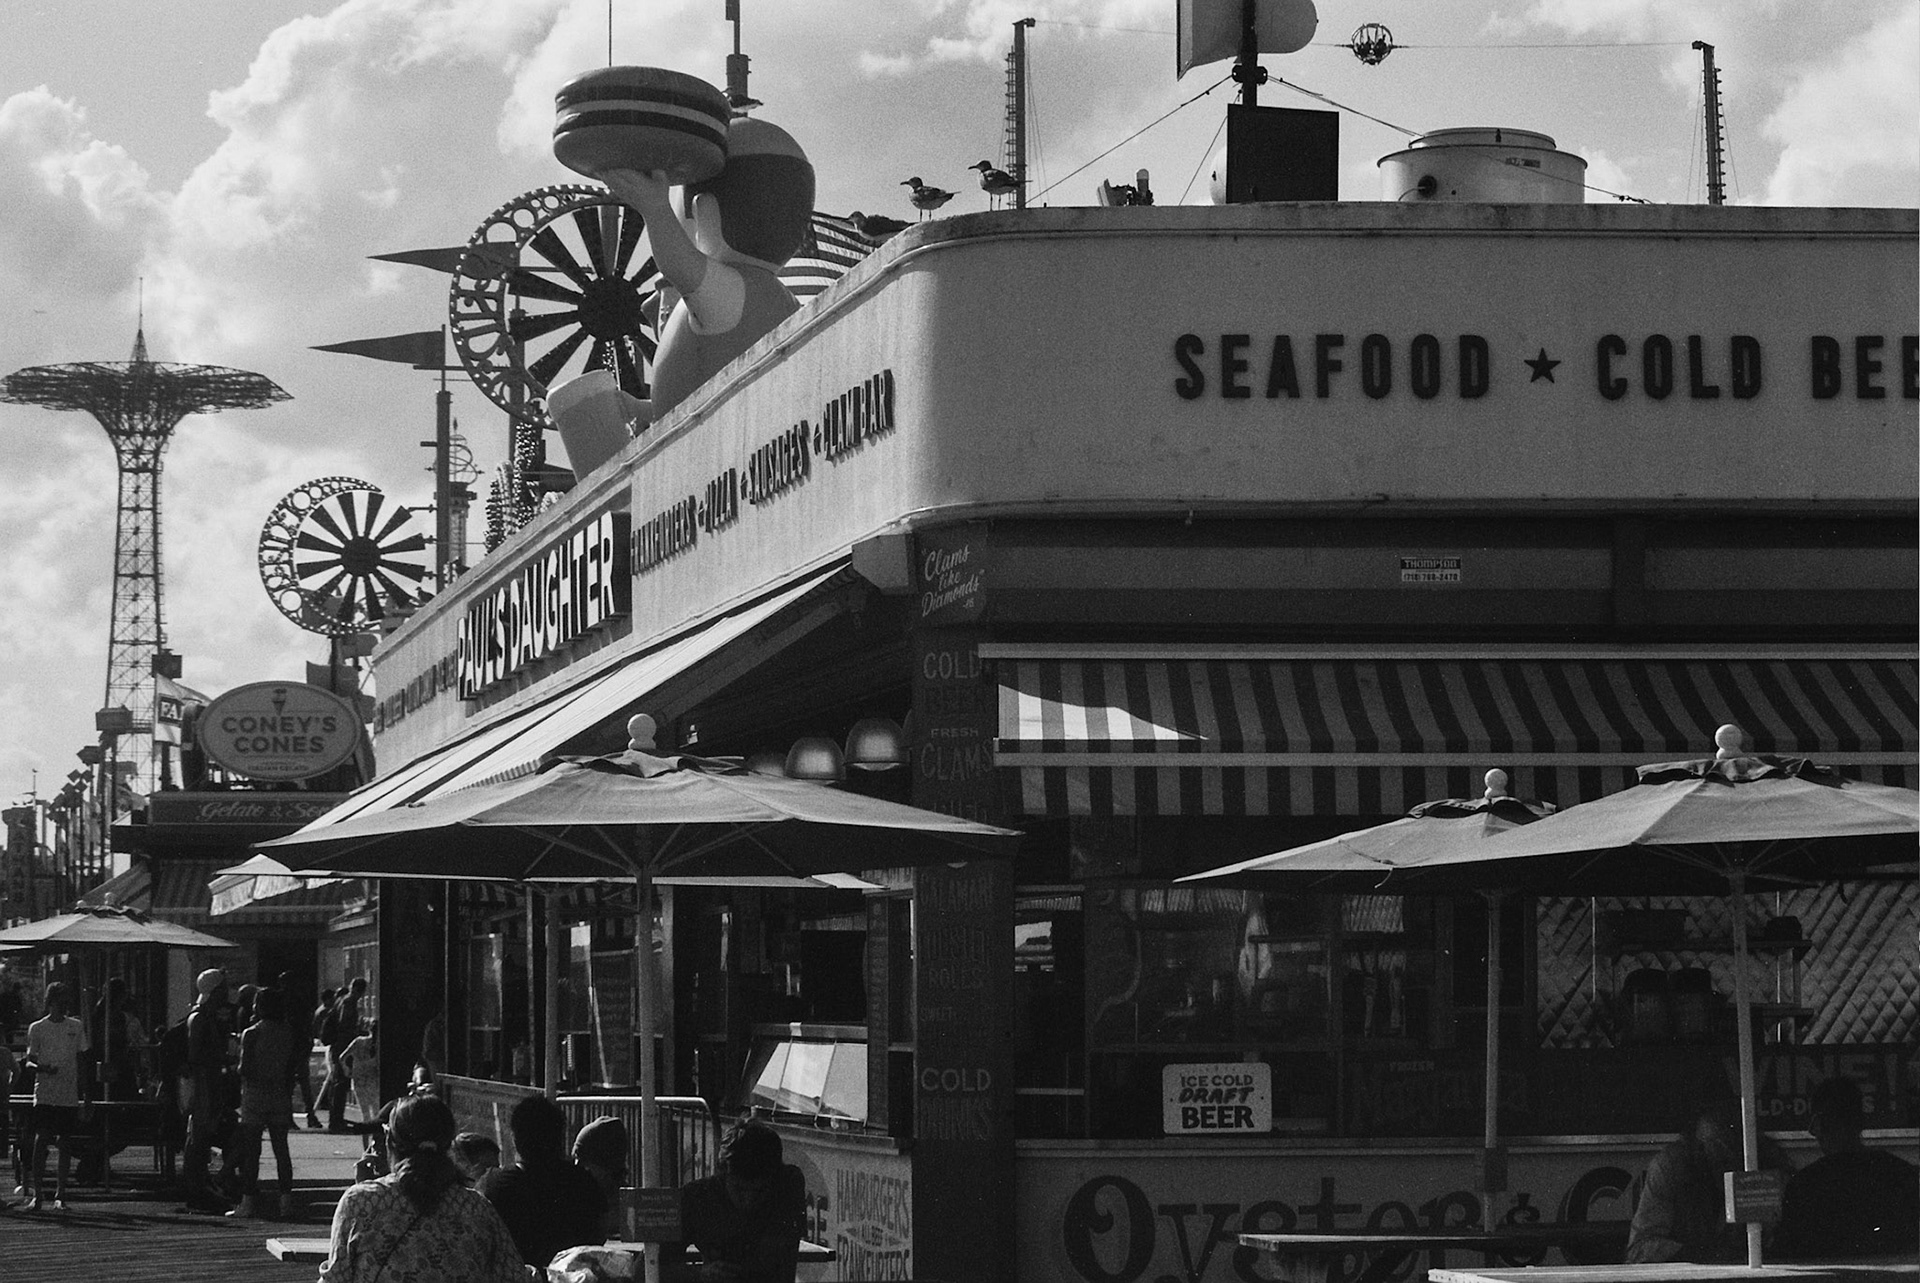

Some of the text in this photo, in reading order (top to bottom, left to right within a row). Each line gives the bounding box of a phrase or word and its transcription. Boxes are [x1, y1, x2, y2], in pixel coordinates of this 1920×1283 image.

[1174, 335, 1489, 399] SEAFOOD
[1596, 335, 1762, 399] COLD
[749, 420, 810, 505] SAUSAGES
[823, 386, 861, 460] CLAM
[860, 369, 894, 441] BAR
[459, 587, 506, 701] PAUL'S
[510, 511, 615, 671] DAUGHTER
[923, 651, 983, 680] COLD
[222, 715, 337, 734] CONEY'S
[931, 727, 980, 739] FRESH
[234, 736, 325, 755] CONES
[921, 740, 993, 781] CLAMS
[197, 801, 266, 821] Gelato
[921, 1067, 991, 1092] COLD
[1181, 1074, 1253, 1087] ICE COLD
[1179, 1086, 1255, 1104] DRAFT
[1182, 1105, 1255, 1129] BEER
[837, 1168, 910, 1240] HAMBURGERS
